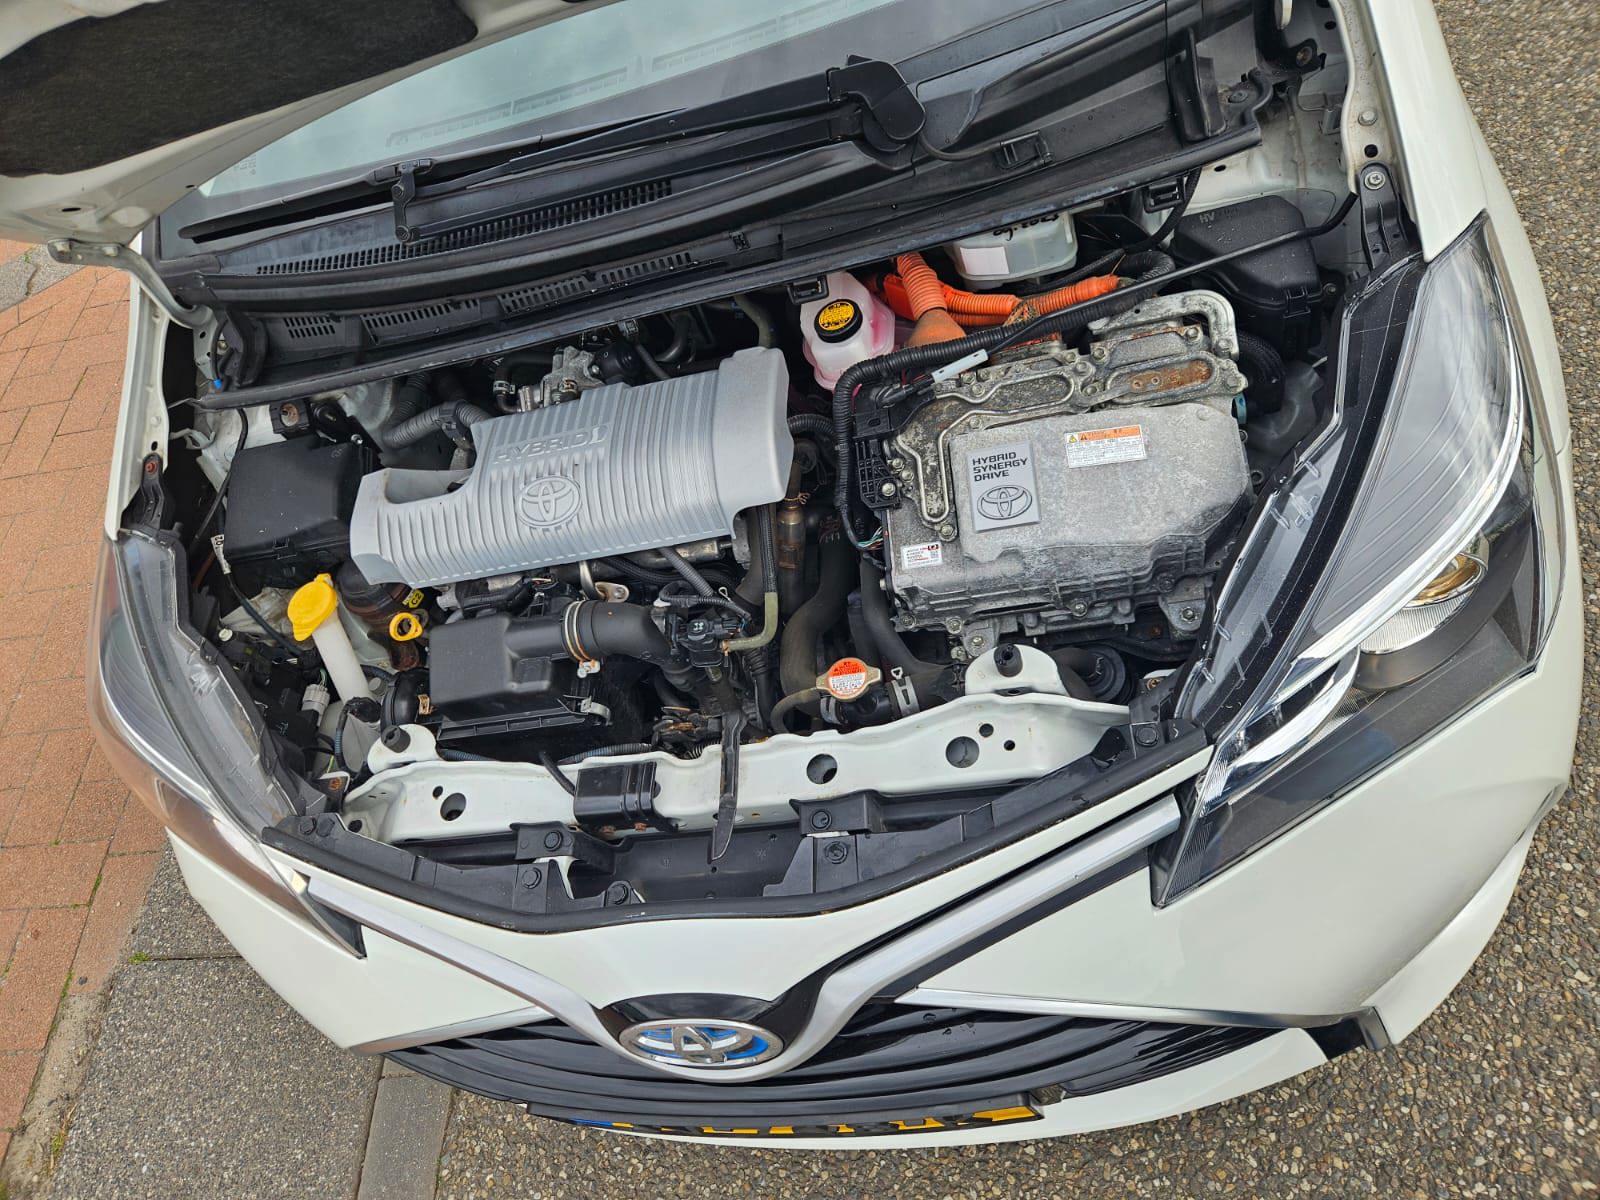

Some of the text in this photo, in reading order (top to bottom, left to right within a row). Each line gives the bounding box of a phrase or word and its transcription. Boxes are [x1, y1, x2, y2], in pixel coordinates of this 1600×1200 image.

[491, 430, 590, 466] HYBRID
[972, 451, 1017, 466] HYBRID
[973, 457, 1028, 474] SYNERGY
[974, 469, 1010, 482] DRIVE
